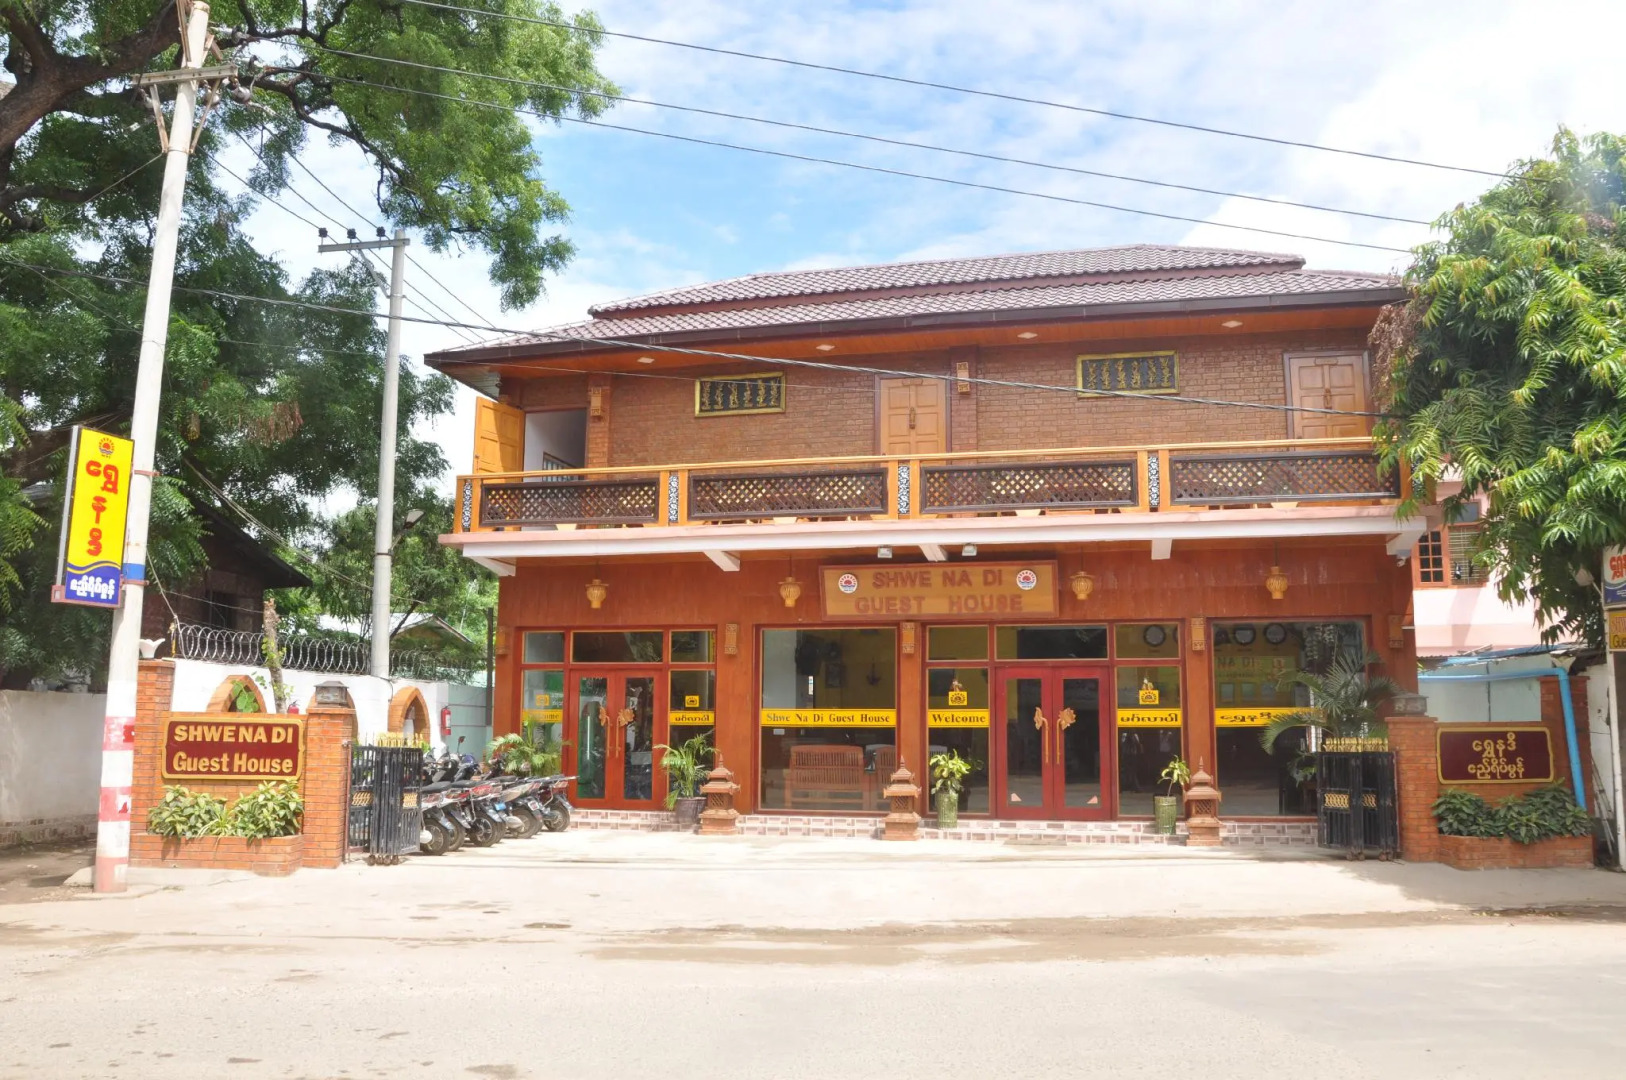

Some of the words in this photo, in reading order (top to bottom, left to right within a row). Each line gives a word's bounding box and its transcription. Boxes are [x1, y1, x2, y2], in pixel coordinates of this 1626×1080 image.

[872, 571, 932, 589] SHWE
[941, 570, 973, 588] NA
[983, 569, 1003, 586] DI
[855, 596, 926, 614] GUEST
[948, 594, 1023, 613] HOUSE
[766, 713, 791, 722] Shwe
[795, 713, 808, 723] Na
[813, 713, 824, 723] Di
[828, 713, 855, 723] Guest
[860, 713, 890, 723] House
[932, 713, 986, 723] Welcome
[173, 724, 236, 742] SHWE
[238, 725, 267, 743] NA
[271, 726, 294, 744] DI
[172, 751, 229, 772] Guest
[233, 752, 294, 773] House
